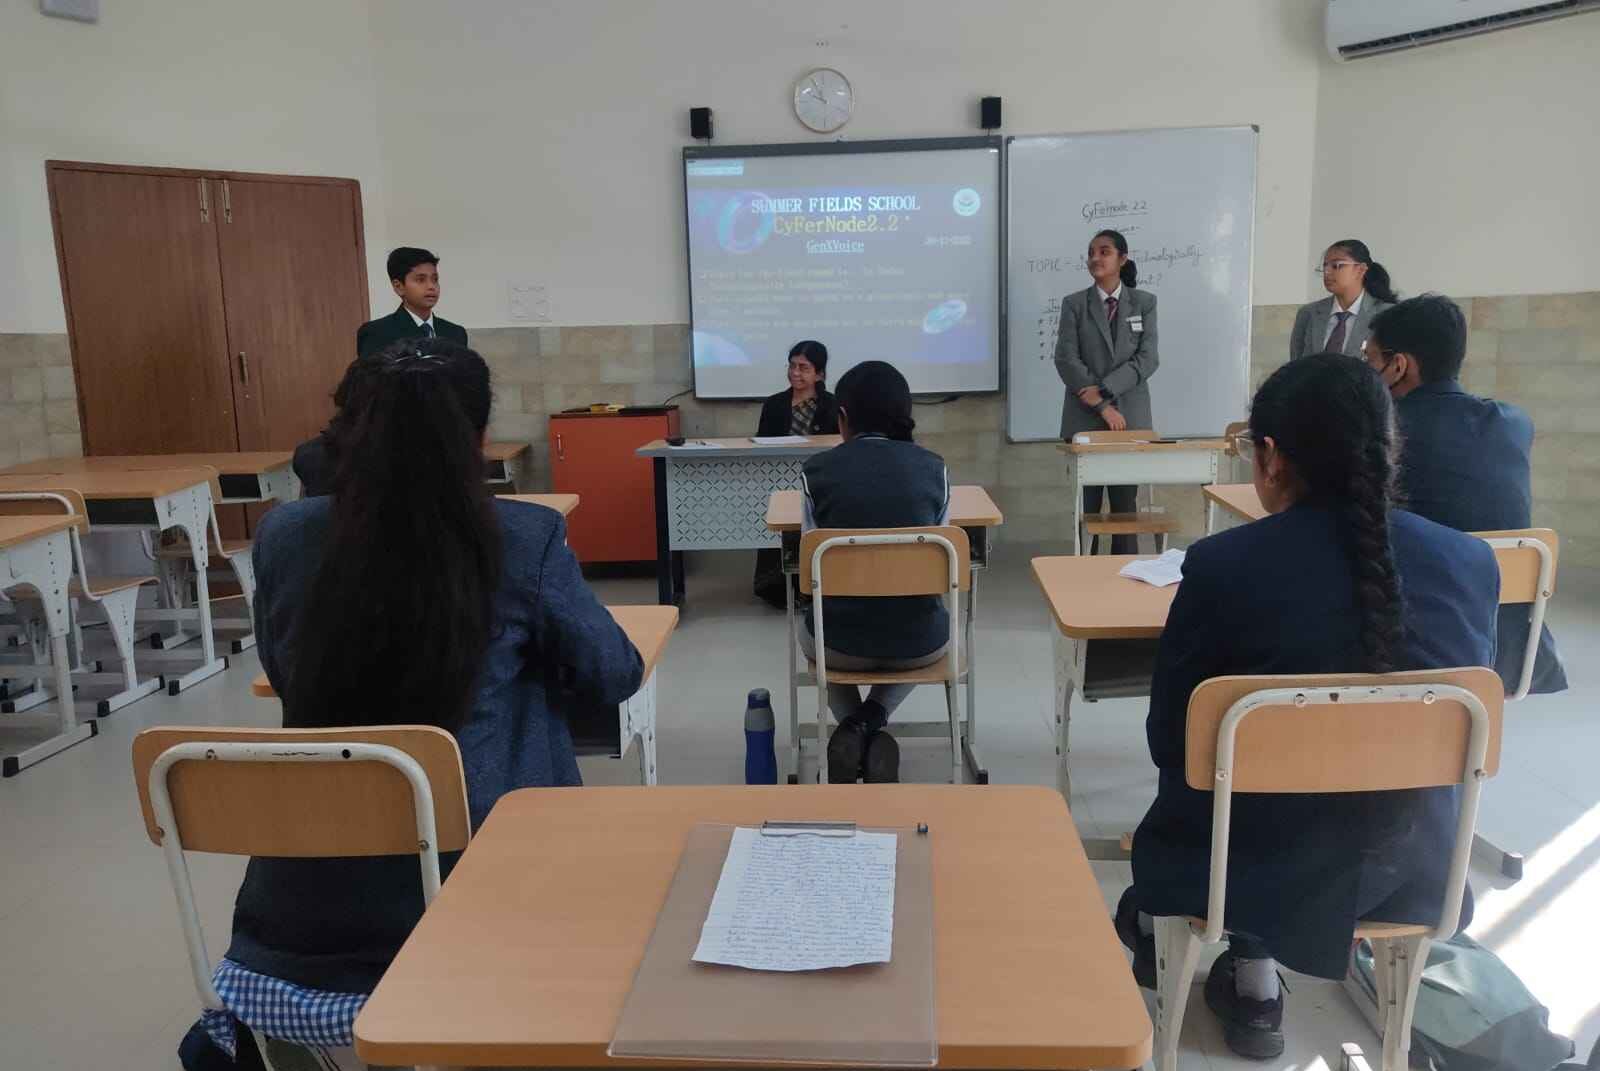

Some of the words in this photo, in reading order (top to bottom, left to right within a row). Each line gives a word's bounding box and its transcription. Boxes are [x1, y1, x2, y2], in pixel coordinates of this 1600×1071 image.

[751, 197, 802, 214] SUMMER
[809, 196, 862, 213] FIELDS
[868, 195, 921, 212] SCHOOL
[774, 214, 899, 236] CyFerNode2.2
[1027, 257, 1063, 273] TOPIC
